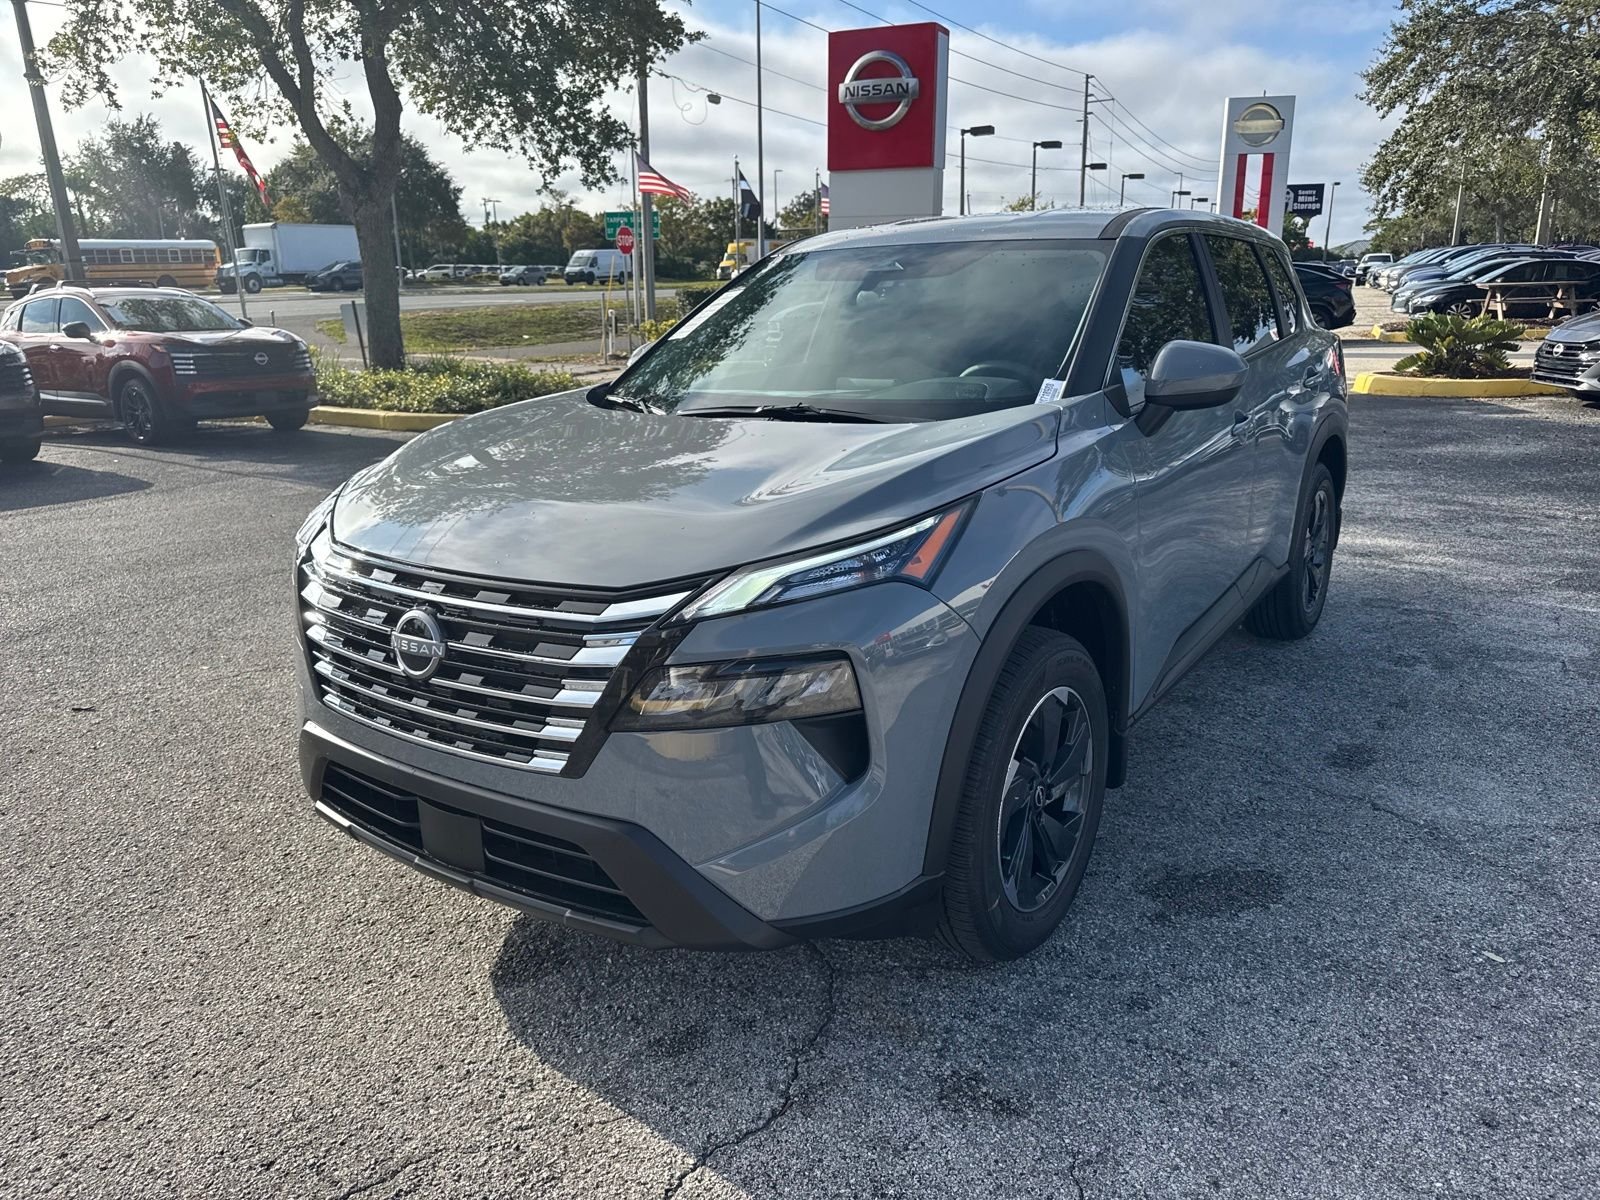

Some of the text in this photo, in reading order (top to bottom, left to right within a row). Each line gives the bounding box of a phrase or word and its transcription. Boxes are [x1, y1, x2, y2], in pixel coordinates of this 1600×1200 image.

[845, 83, 909, 98] NISSAN
[617, 235, 633, 246] STOP
[391, 635, 443, 656] NISSAN
